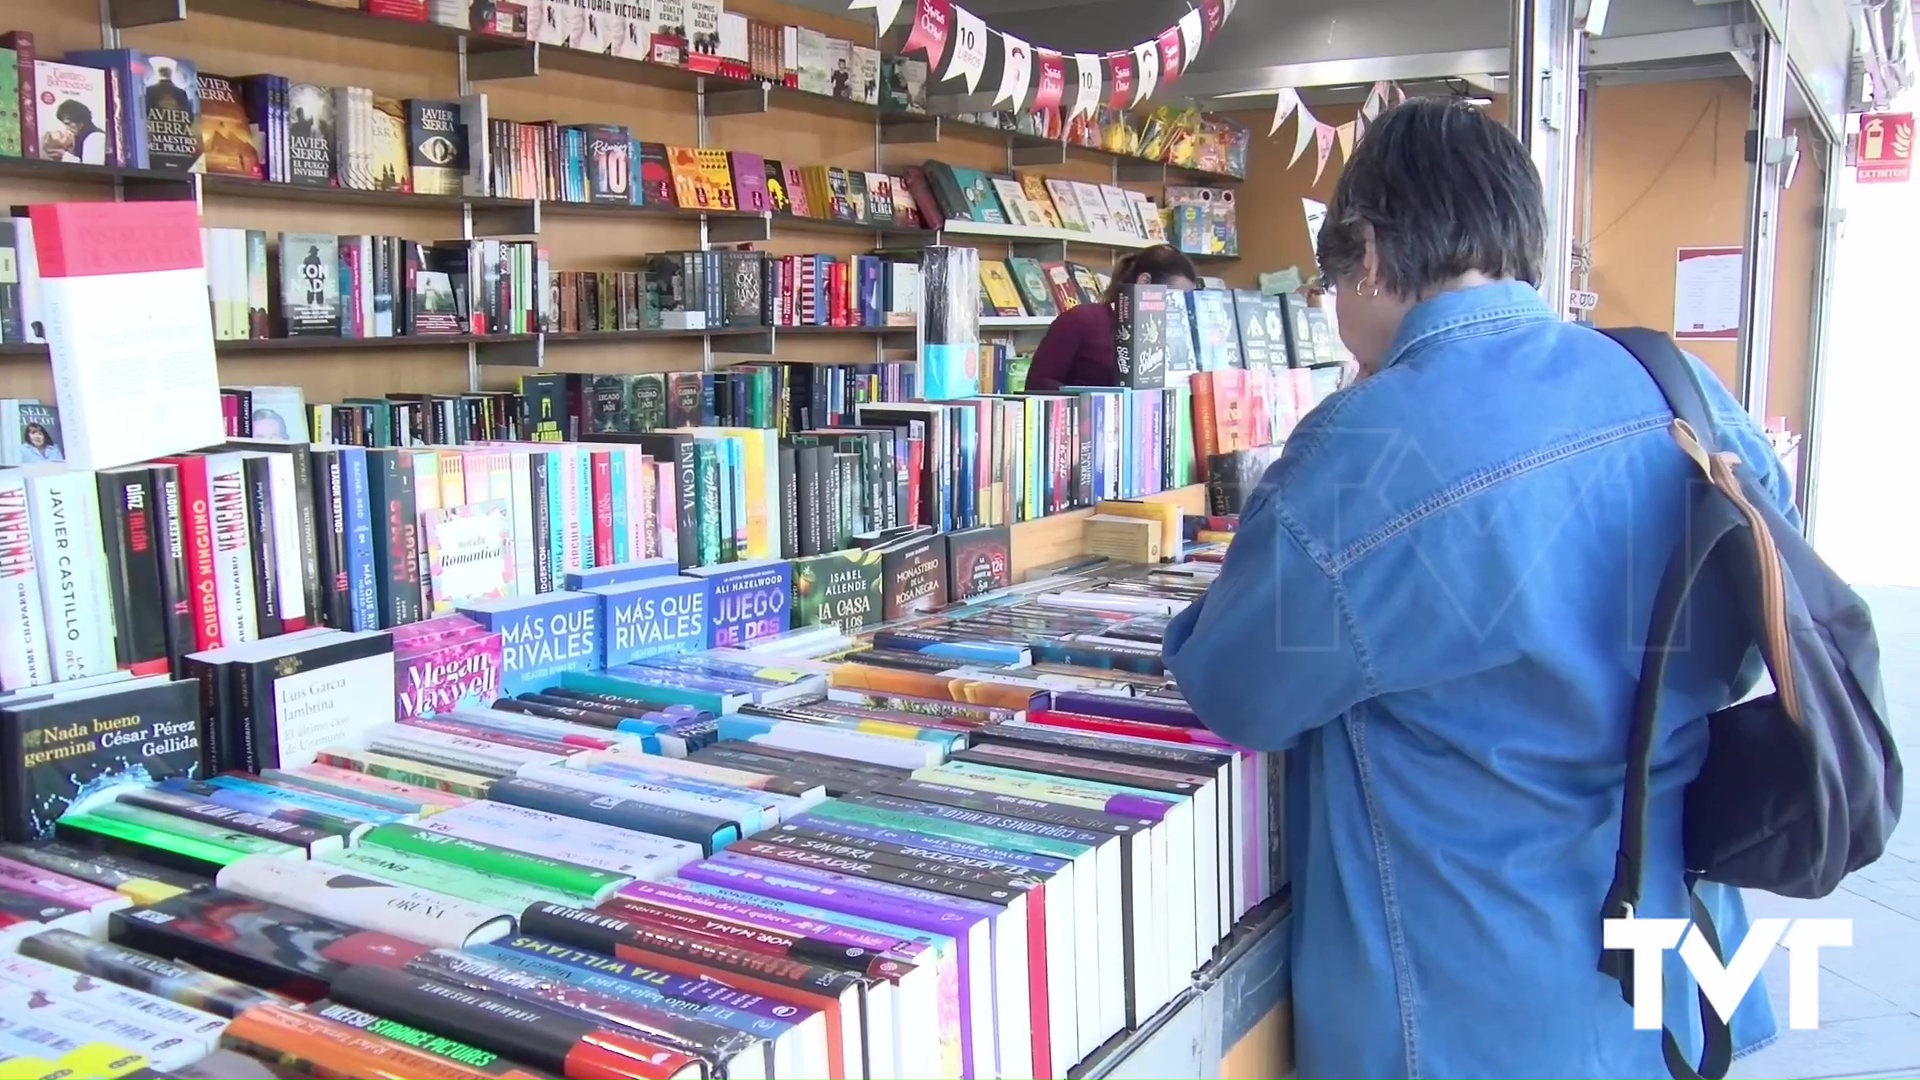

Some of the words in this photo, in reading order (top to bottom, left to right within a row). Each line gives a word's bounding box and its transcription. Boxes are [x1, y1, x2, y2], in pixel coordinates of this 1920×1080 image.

[614, 3, 650, 22] VICTORIA
[960, 27, 974, 50] 10
[1081, 72, 1093, 89] 10
[421, 107, 454, 122] JAVIER
[422, 119, 455, 132] SIERRA
[291, 136, 328, 150] JAVIER
[291, 148, 330, 162] SIERRA
[293, 167, 329, 178] INVISIBLE
[308, 161, 329, 171] FUEGO
[595, 152, 628, 193] 10
[1858, 167, 1909, 179] EXTINTOR
[297, 264, 329, 280] CON
[330, 463, 341, 499] HOOVER
[352, 460, 362, 495] RACHEL
[680, 442, 696, 510] ENIGMA
[125, 483, 145, 510] DÍAZ
[165, 481, 177, 517] HOOVER
[356, 496, 364, 520] REID
[49, 488, 69, 550] JAVIER
[212, 471, 247, 552] VENGANZA
[333, 499, 344, 534] COLLEEN
[128, 511, 148, 552] TALIÓN
[168, 517, 182, 558] COLLEEN
[193, 499, 214, 574] NINGUNO
[362, 563, 372, 583] MÁS
[830, 570, 863, 582] ISABEL
[896, 559, 939, 583] MONASTERIO
[230, 556, 243, 612] CHAPARRO
[366, 585, 374, 607] QUE
[715, 583, 730, 595] ALI
[732, 575, 783, 592] HAZELWOOD
[825, 579, 868, 596] ALLENDE
[915, 580, 940, 599] NEGRA
[58, 555, 80, 641] CASTILLO
[197, 578, 219, 638] QUEDÓ
[615, 598, 655, 626] MÁS
[661, 592, 704, 617] QUE
[713, 587, 785, 626] JUEGO
[818, 602, 832, 621] LA
[837, 596, 871, 617] CASA
[501, 615, 544, 648] MÁS
[551, 608, 595, 634] QUE
[615, 614, 702, 651] RIVALES
[715, 625, 739, 647] DE
[745, 618, 780, 640] DOS
[845, 615, 864, 628] LOS
[503, 631, 594, 673] RIVALES
[408, 652, 489, 691] Megan
[281, 687, 306, 704] Luis
[309, 677, 347, 697] García
[400, 664, 499, 718] Maxwell
[282, 697, 335, 723] Jambrina
[43, 722, 89, 744] Nada
[93, 713, 141, 733] bueno
[283, 726, 295, 742] El
[297, 719, 328, 739] último
[24, 739, 97, 768] germina
[101, 729, 149, 748] César
[151, 719, 196, 738] Pérez
[142, 735, 199, 758] Gellida
[944, 809, 980, 824] HIELO
[981, 815, 998, 827] DE
[999, 816, 1076, 840] CORAZONES
[769, 834, 794, 845] LA
[800, 840, 875, 860] SOMBRA
[914, 861, 985, 880] RUNYX
[950, 841, 978, 852] QUE
[981, 846, 1033, 862] RIVALES
[750, 844, 772, 855] EL
[775, 849, 874, 873] CAZADOR
[897, 872, 968, 890] RUNYX
[541, 904, 598, 927] WINSLOW
[655, 888, 713, 909] maldición
[750, 908, 791, 926] quiero
[599, 916, 631, 931] DON
[703, 920, 744, 940] MAMÁ
[510, 937, 627, 974] WILLIAMS
[583, 975, 612, 992] piel
[631, 966, 672, 986] TIA
[417, 982, 483, 1008] TRISTANTE
[627, 985, 661, 1002] bajo
[485, 999, 542, 1024] JERÓNIMO
[319, 1004, 375, 1028] UKETSU
[366, 1018, 432, 1050] STRANGE
[422, 1033, 499, 1068] PICTURES
